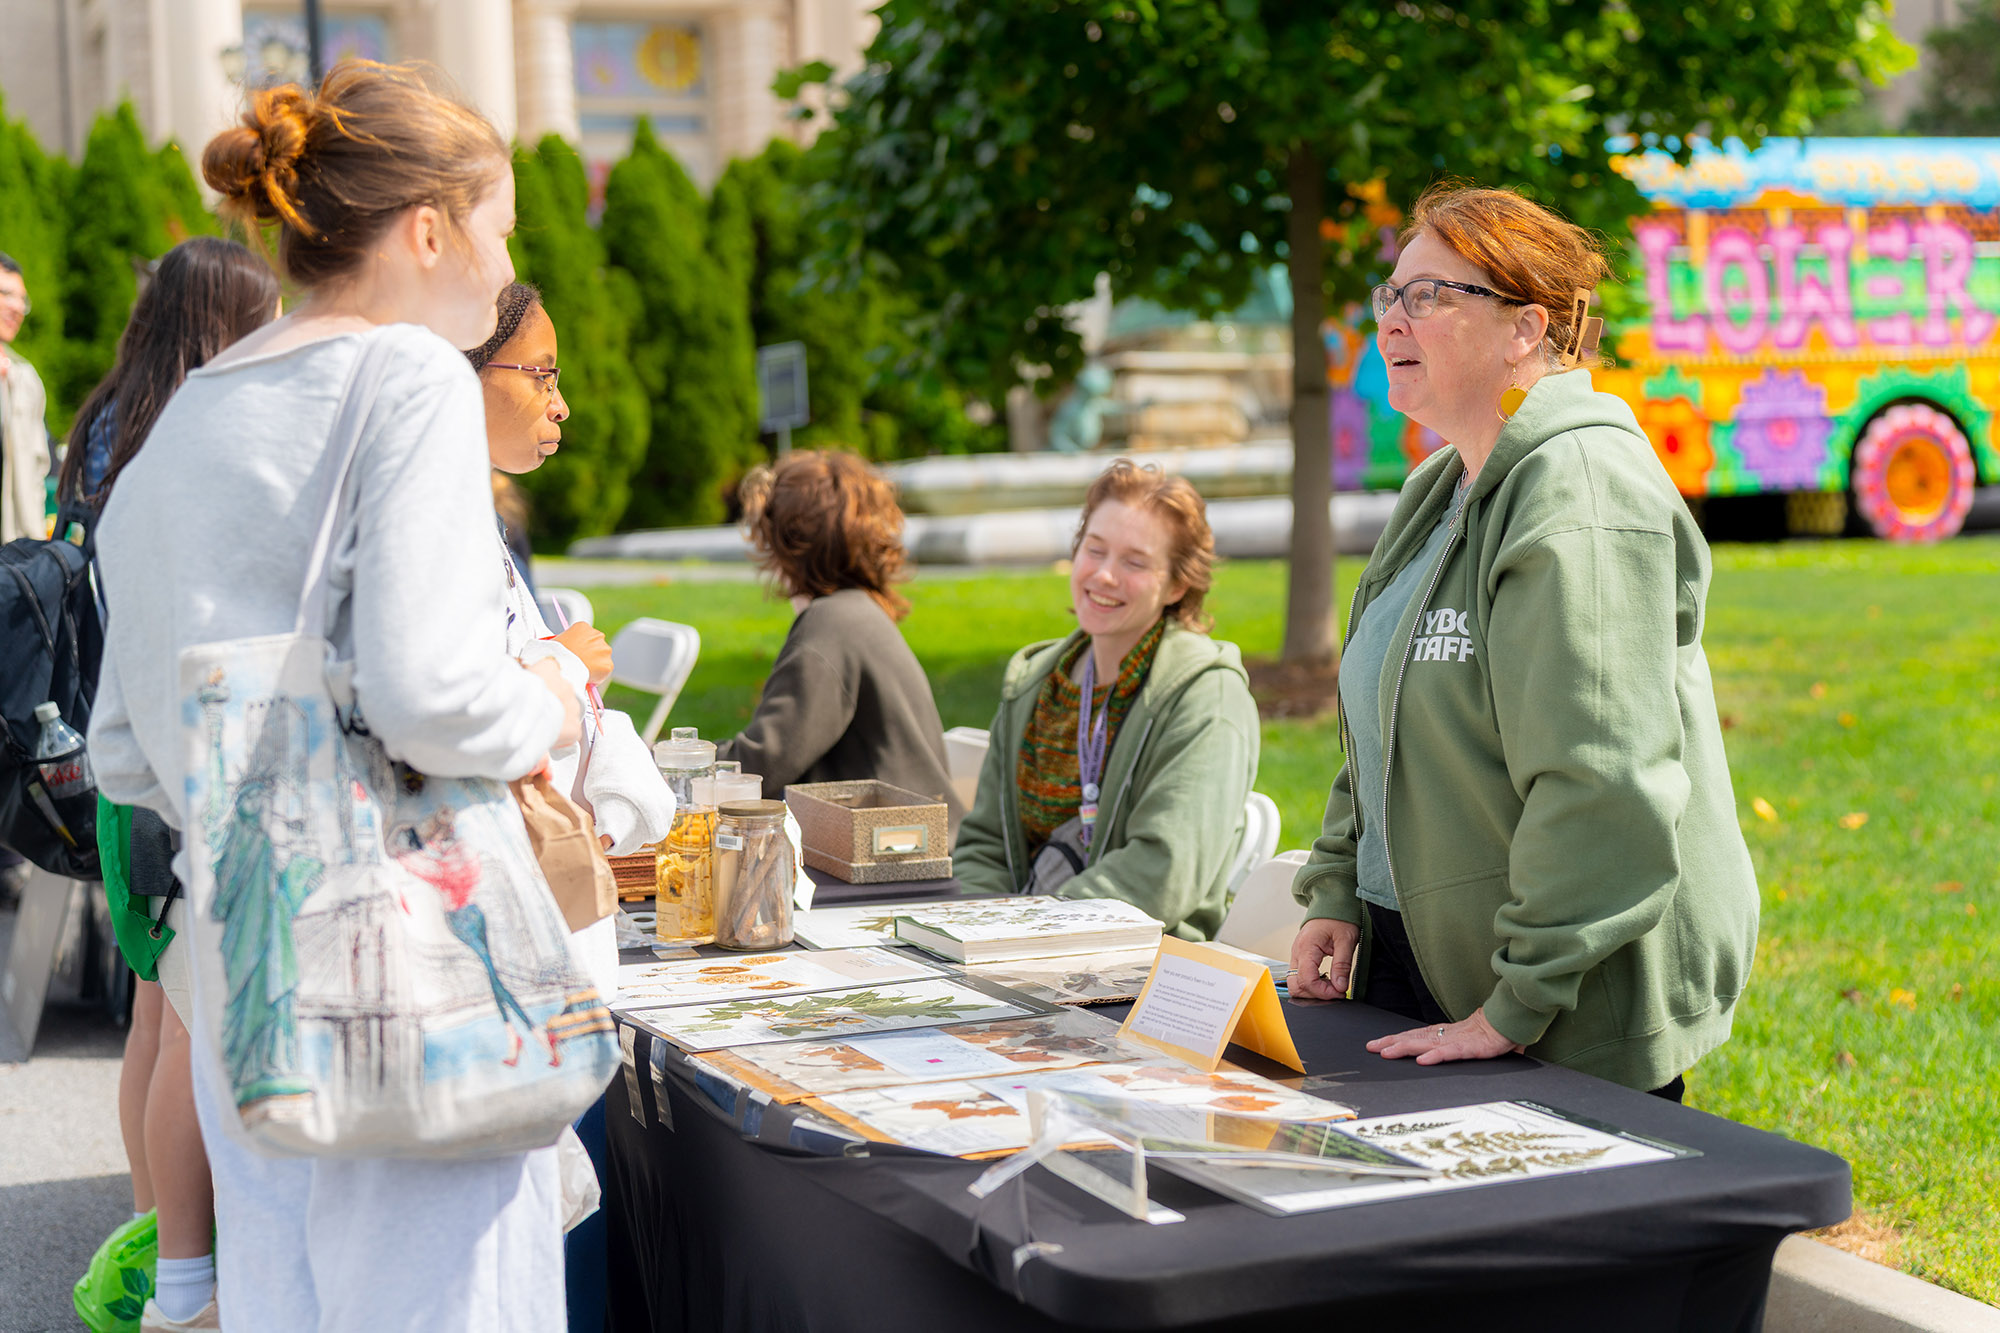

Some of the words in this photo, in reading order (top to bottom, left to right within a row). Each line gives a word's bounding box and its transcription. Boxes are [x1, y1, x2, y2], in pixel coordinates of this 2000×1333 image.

[1417, 608, 1469, 636] YB
[1413, 636, 1474, 662] TAFF
[40, 764, 83, 787] oke
